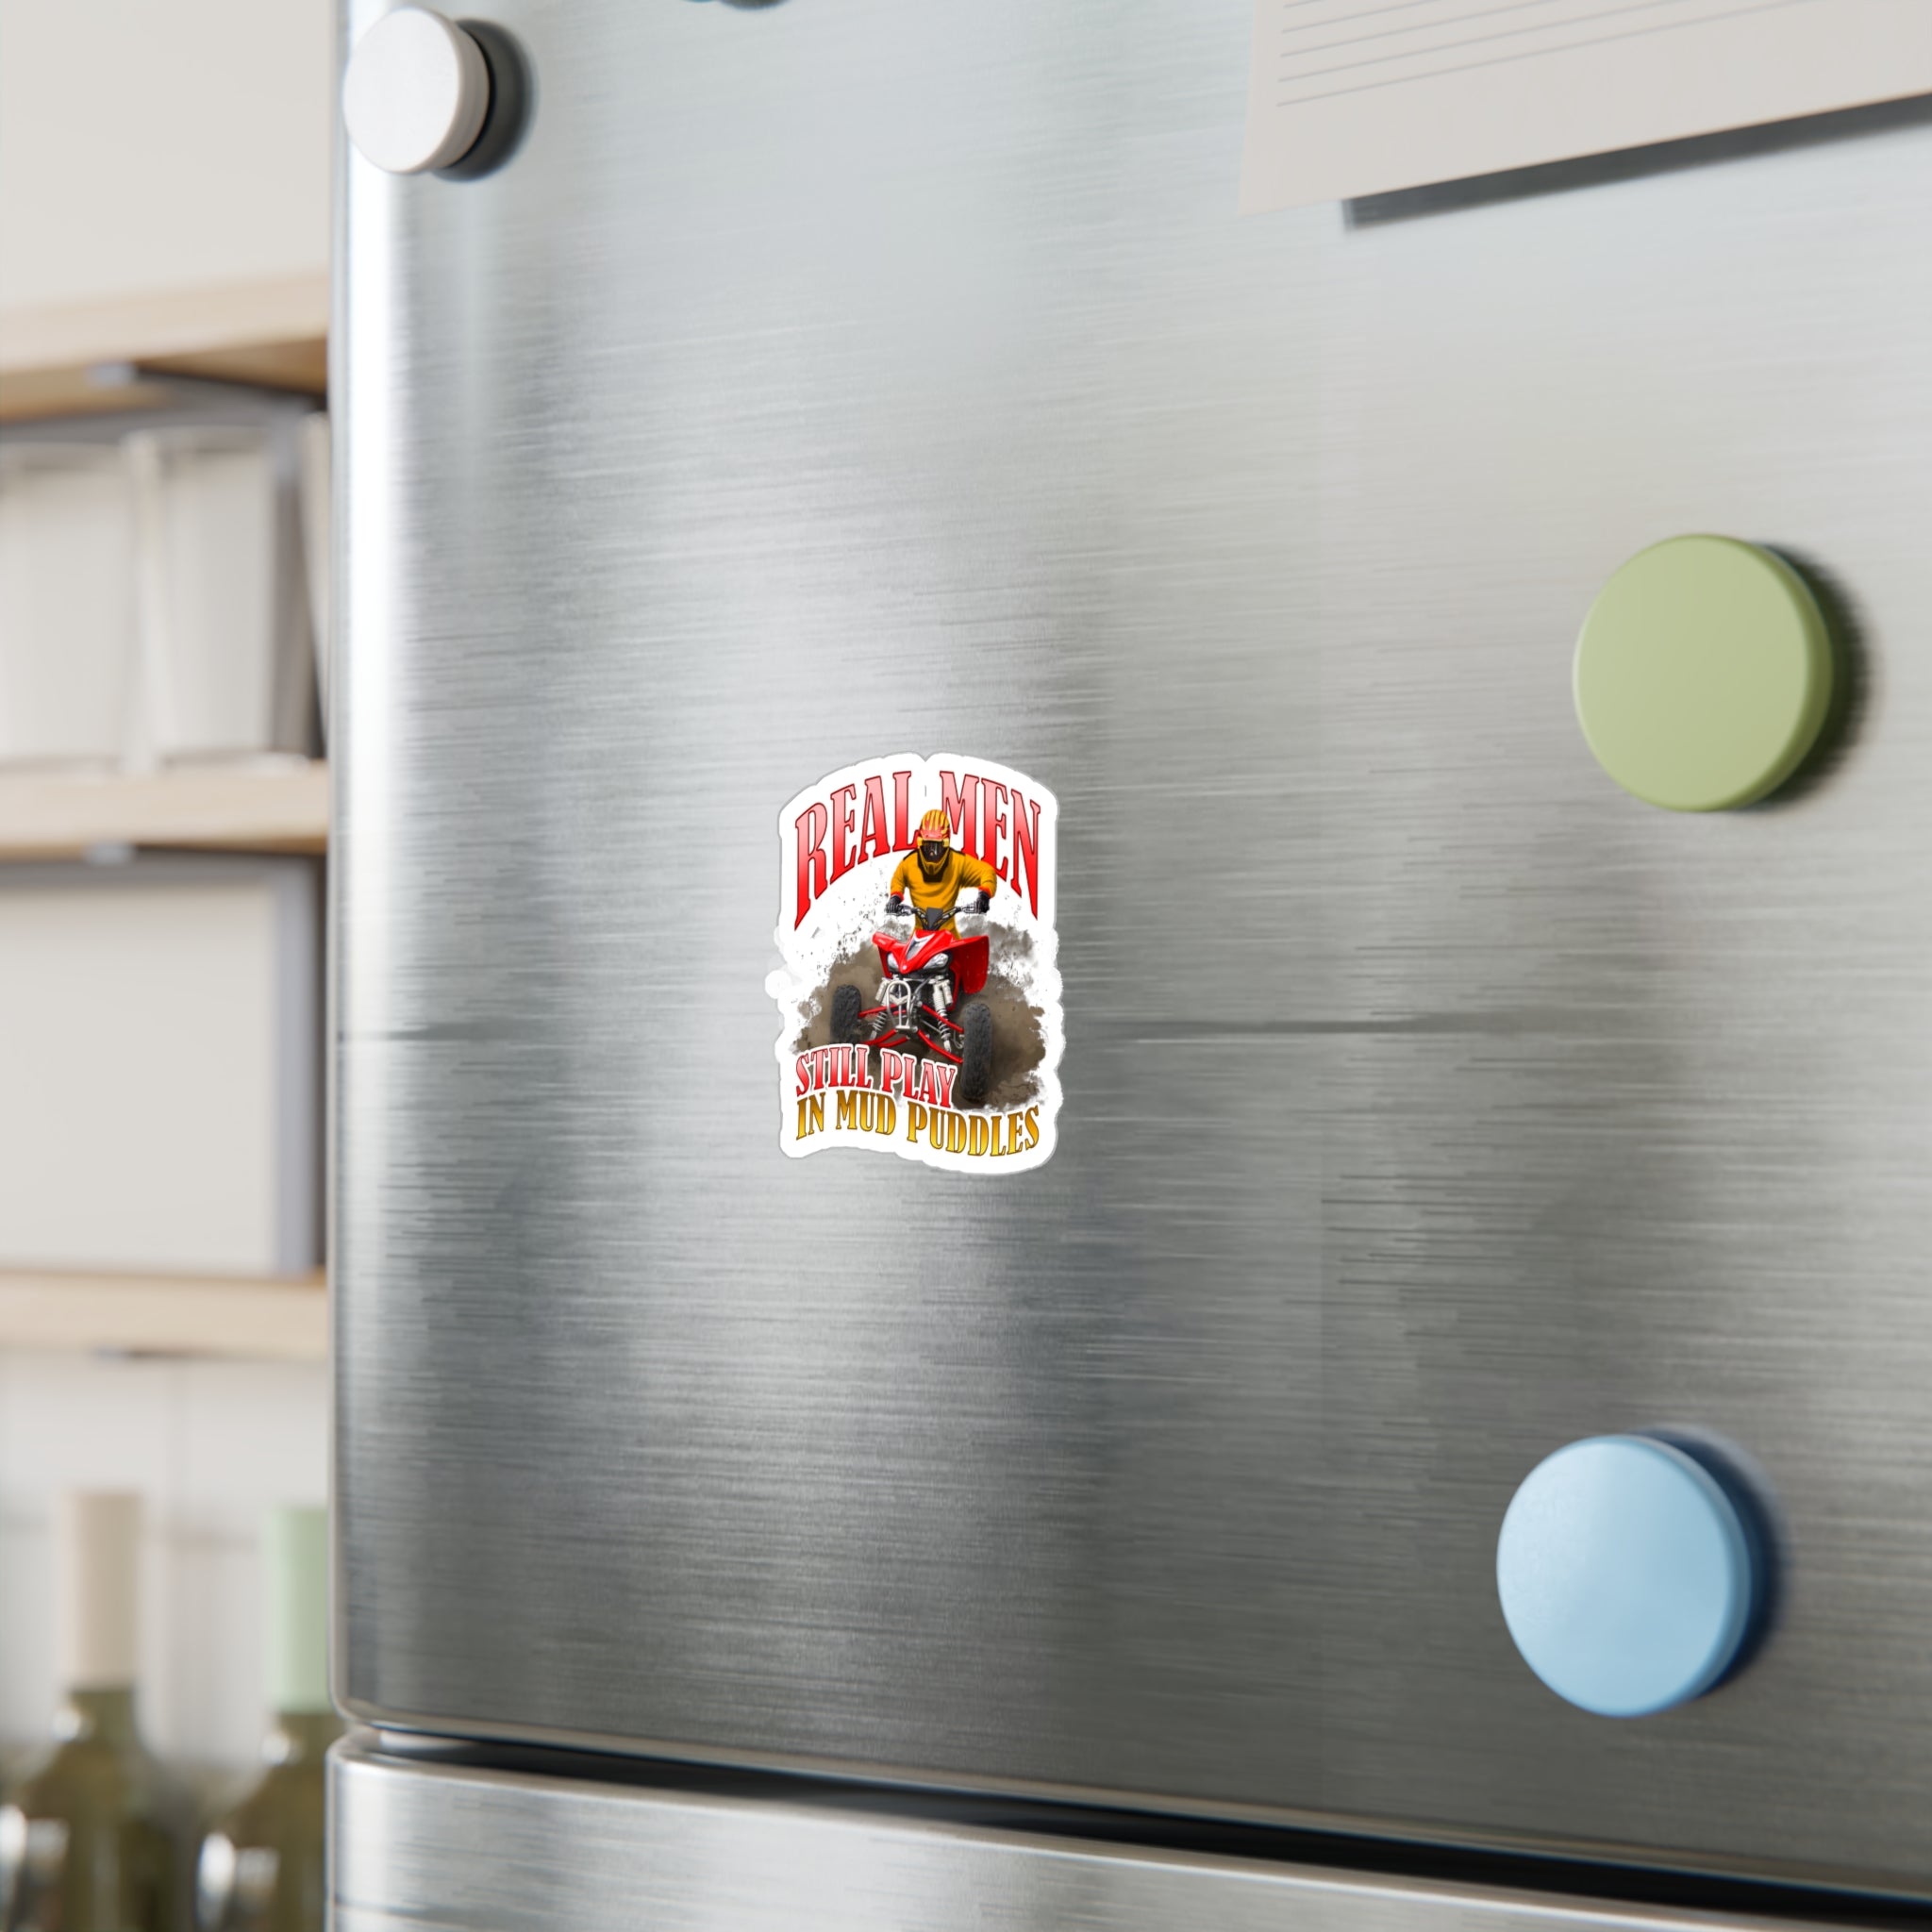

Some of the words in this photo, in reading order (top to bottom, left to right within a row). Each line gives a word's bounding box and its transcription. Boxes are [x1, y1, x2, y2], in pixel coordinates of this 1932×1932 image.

[794, 771, 921, 931] REAL
[940, 771, 1041, 921] MEN
[795, 1046, 873, 1097] STILL
[881, 1051, 957, 1108] PLAY
[796, 1091, 825, 1141] IN
[835, 1090, 896, 1136] MUD
[907, 1101, 1040, 1157] PUDDLES
